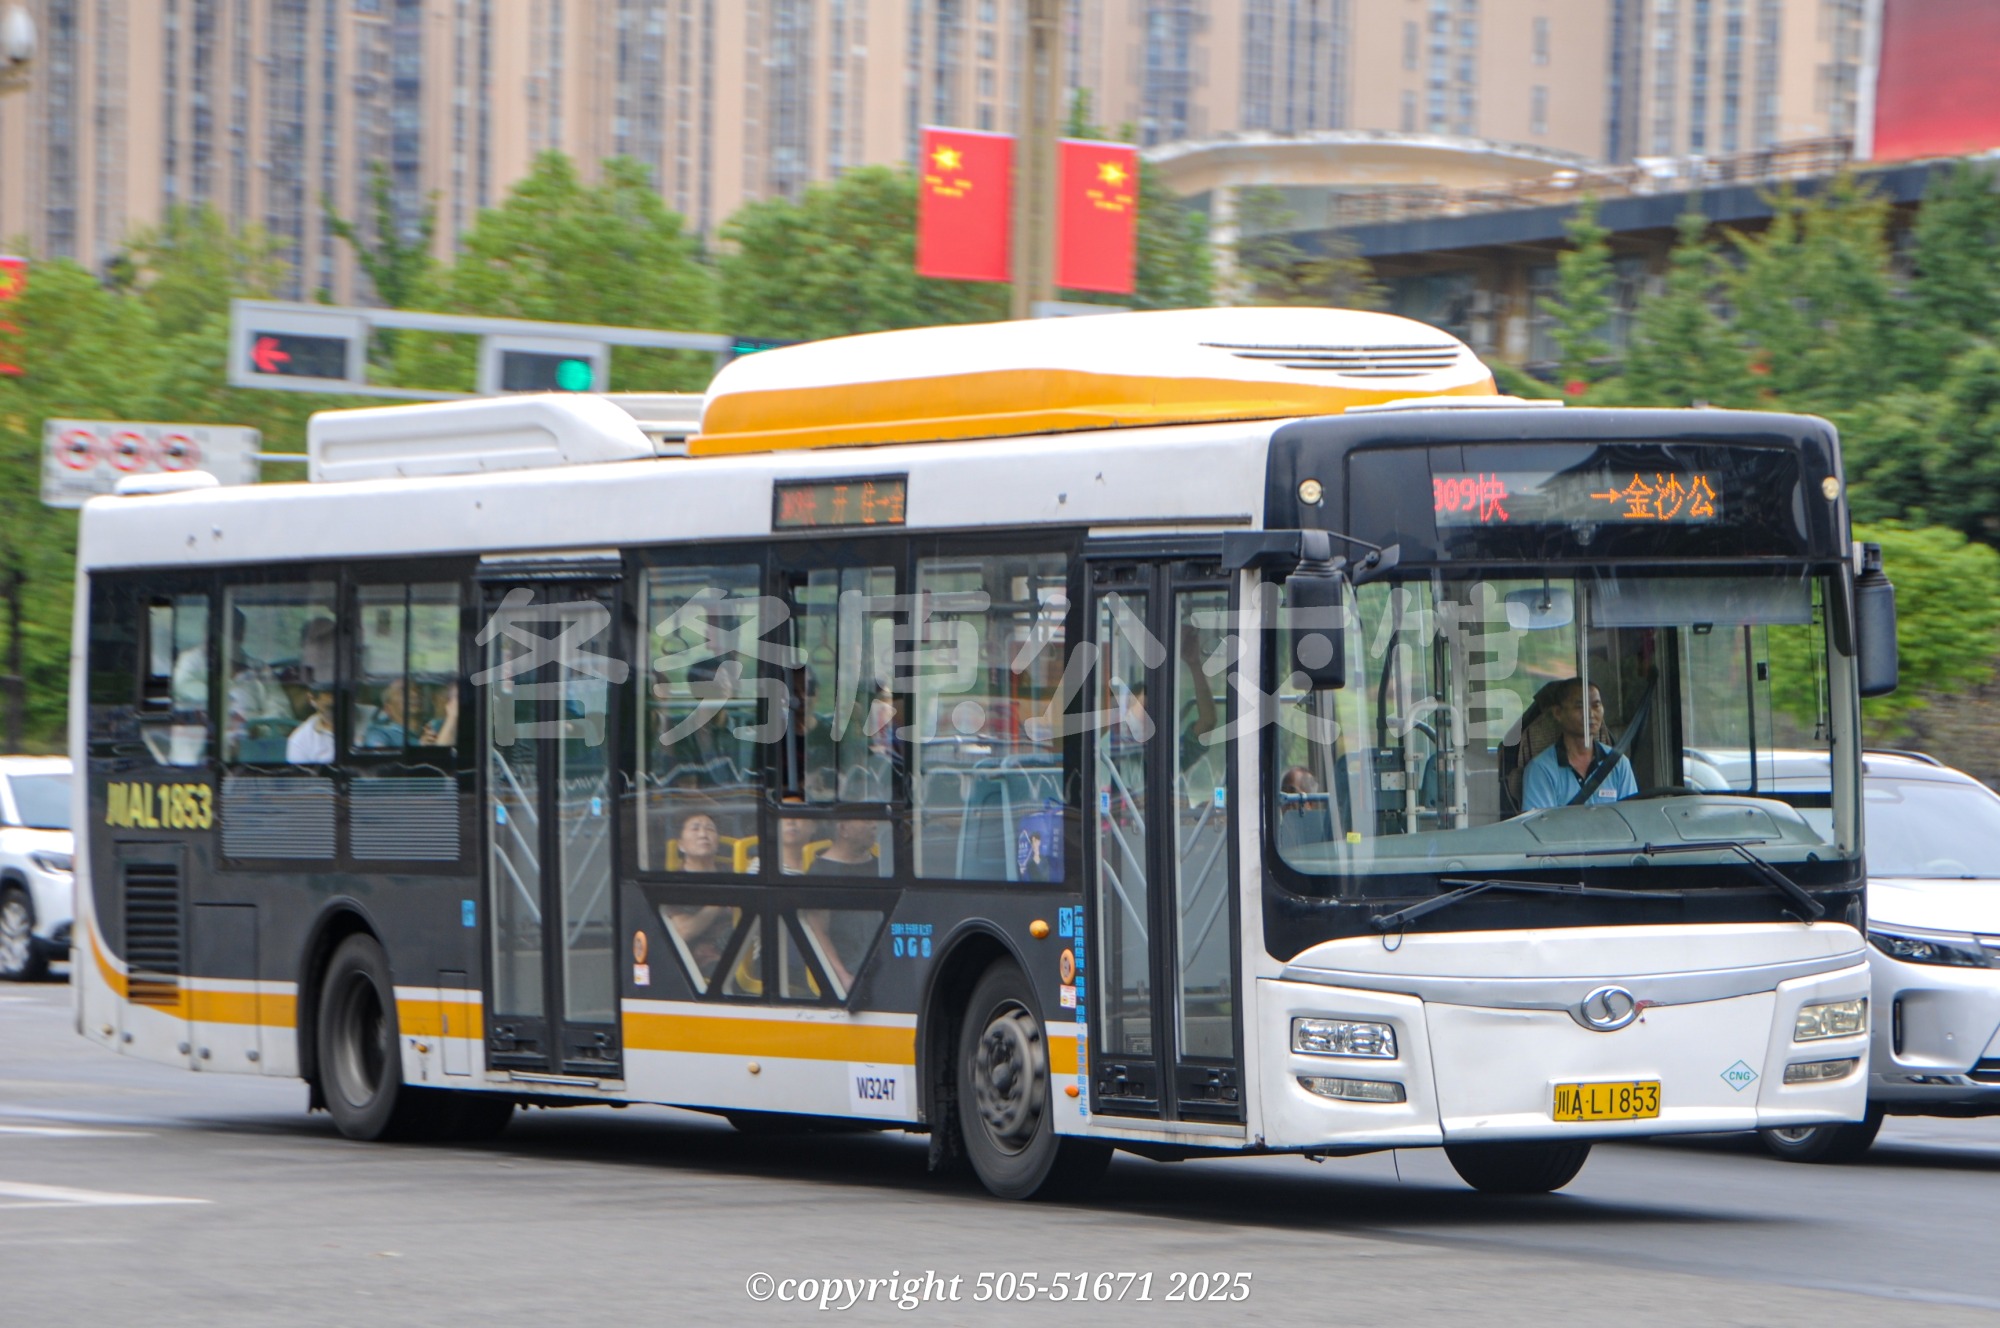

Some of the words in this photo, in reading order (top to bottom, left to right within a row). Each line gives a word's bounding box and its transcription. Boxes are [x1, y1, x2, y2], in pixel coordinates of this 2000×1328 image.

[1433, 472, 1509, 522] 309快
[1622, 472, 1716, 521] 金沙公
[105, 781, 213, 830] 川AL1853
[856, 1076, 896, 1101] W3247
[1729, 1071, 1751, 1081] CNG
